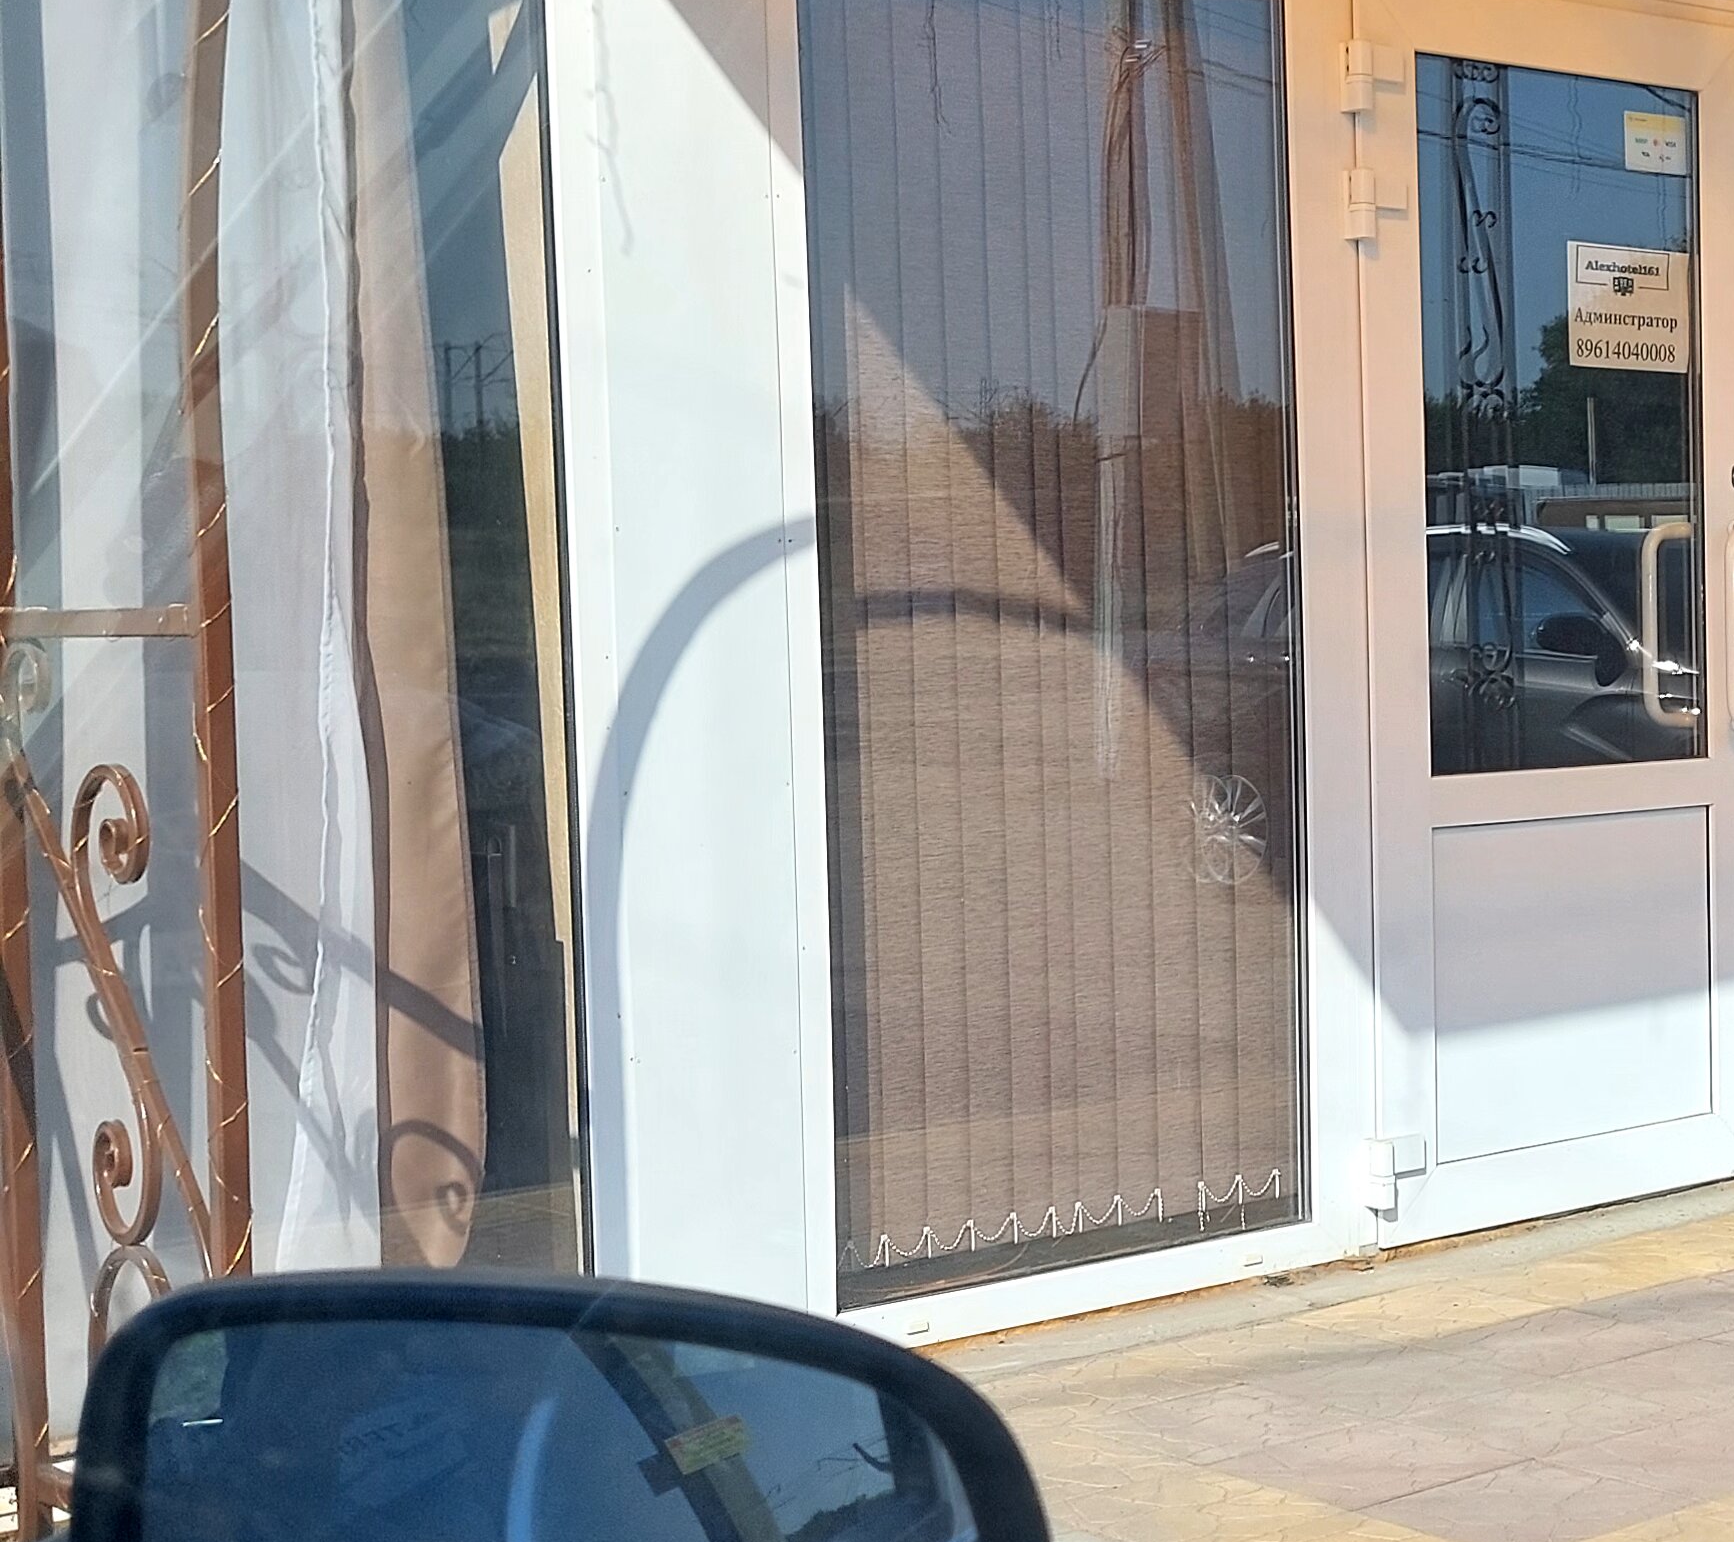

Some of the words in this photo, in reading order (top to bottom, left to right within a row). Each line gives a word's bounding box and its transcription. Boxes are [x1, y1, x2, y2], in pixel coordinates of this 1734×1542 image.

[1585, 260, 1661, 277] Alexhotel161
[1574, 307, 1678, 334] Админстратор
[1576, 338, 1676, 363] 89614040008
